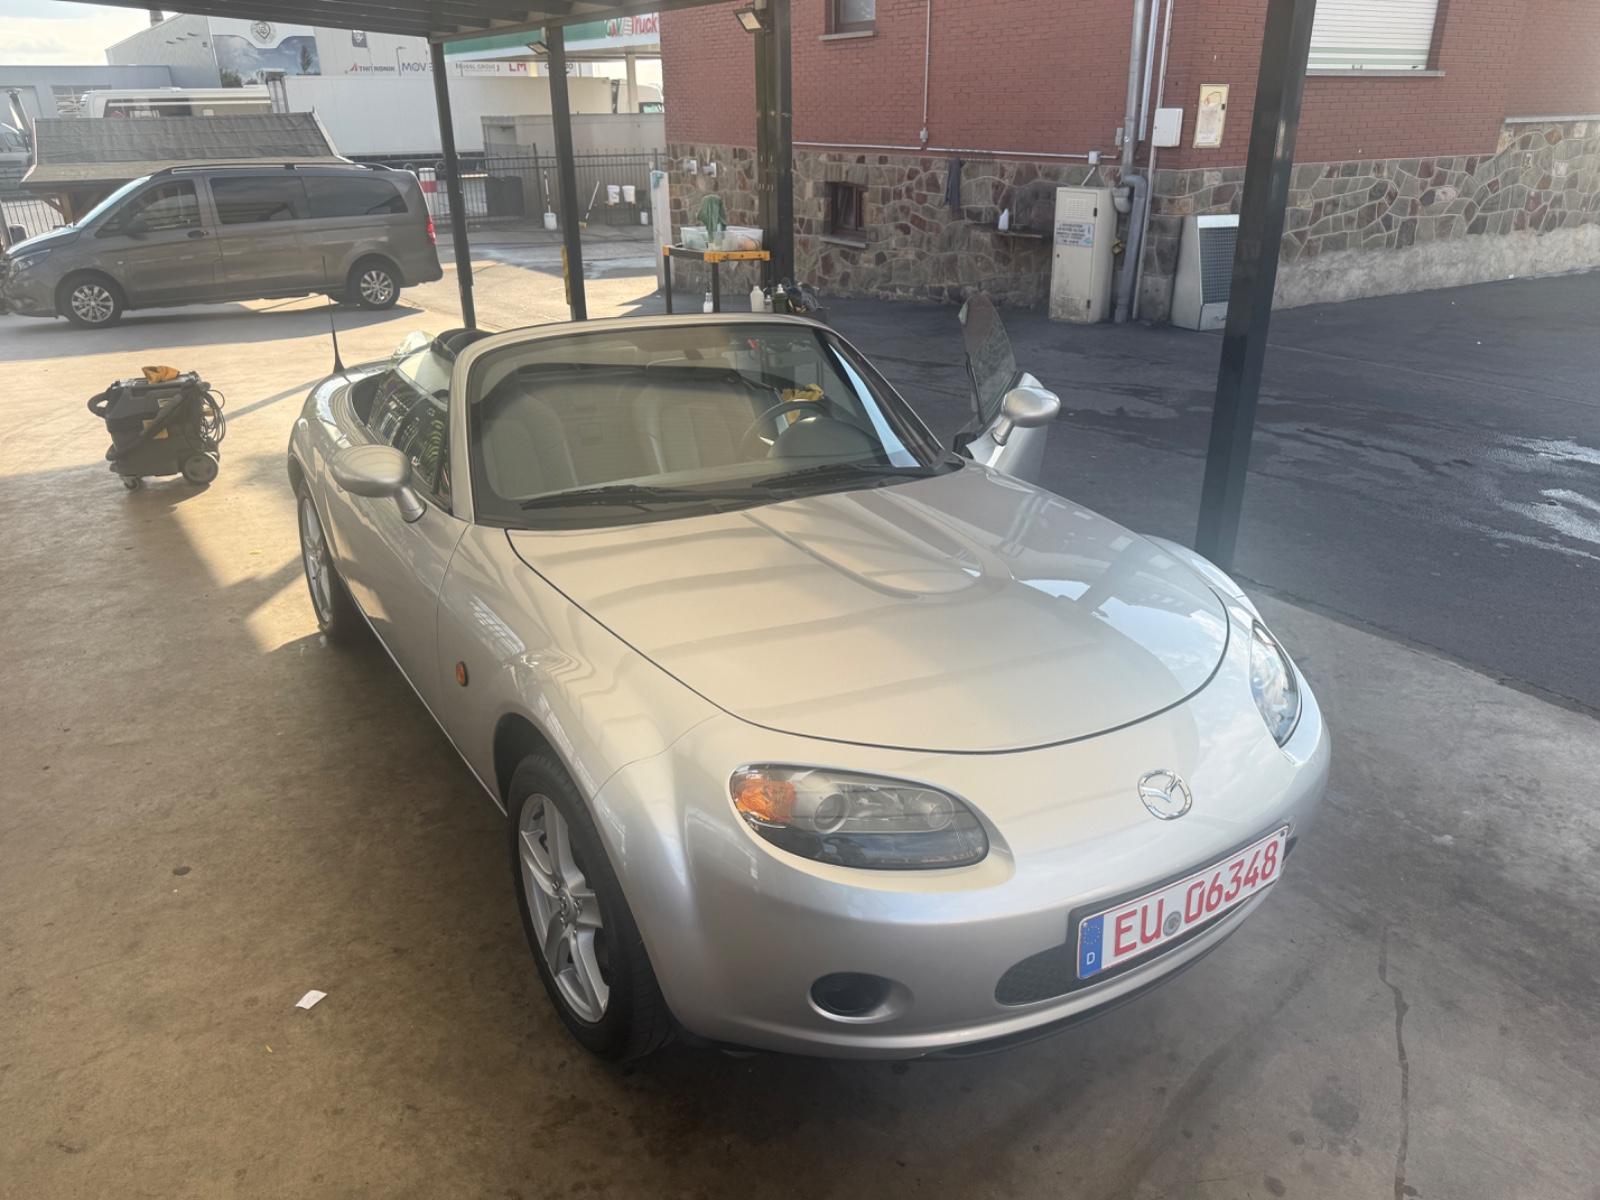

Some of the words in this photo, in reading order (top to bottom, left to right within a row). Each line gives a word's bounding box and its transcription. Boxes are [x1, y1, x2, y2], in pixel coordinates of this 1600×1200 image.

[1114, 898, 1164, 957] EU
[1183, 841, 1278, 924] 06348
[1086, 951, 1096, 966] D
